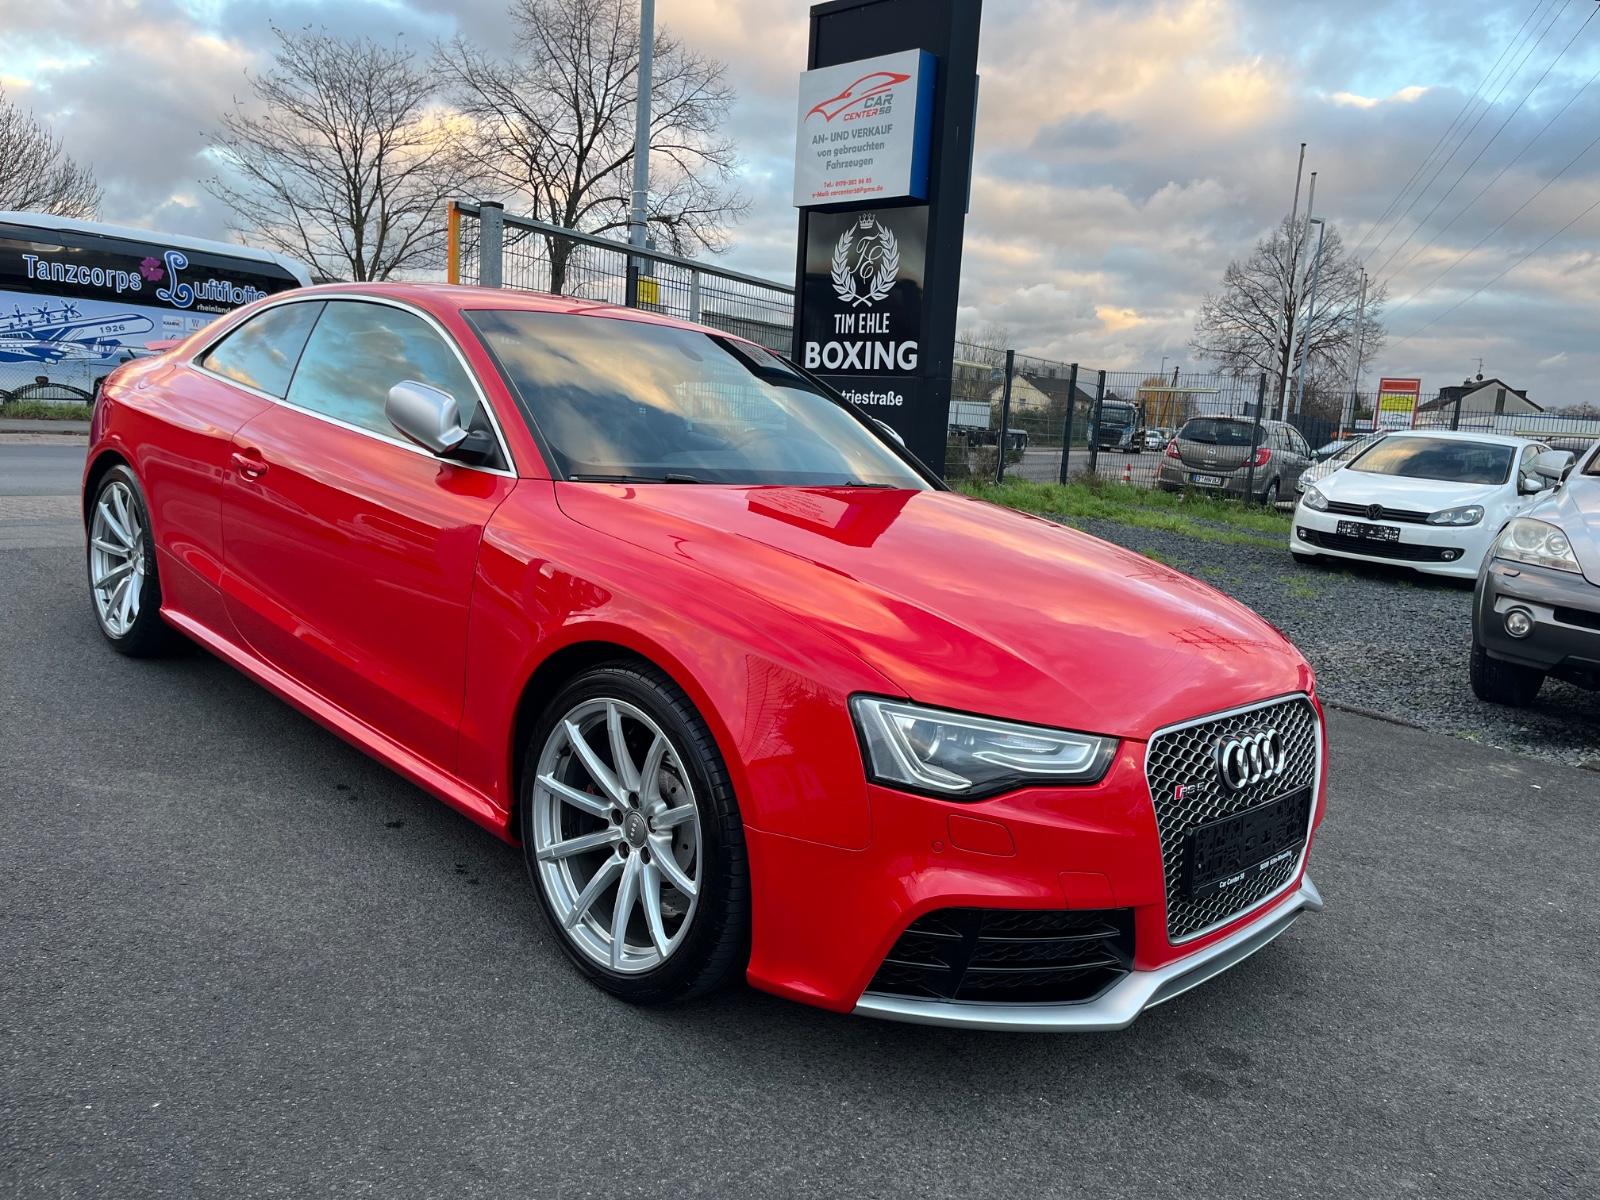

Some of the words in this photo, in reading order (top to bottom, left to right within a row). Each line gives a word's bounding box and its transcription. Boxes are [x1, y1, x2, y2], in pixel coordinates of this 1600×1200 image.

[864, 93, 894, 109] CAR
[812, 134, 828, 145] AN-
[830, 130, 849, 142] UND
[851, 124, 893, 139] VERKAUF
[817, 149, 832, 157] von
[833, 141, 885, 157] gebrauchten
[826, 158, 874, 170] Fahrzeugen
[23, 254, 142, 293] Tanzcorps
[156, 251, 268, 308] Luftflotte
[100, 324, 125, 334] 1926
[834, 314, 855, 334] TIM
[859, 313, 890, 333] EHLE
[805, 341, 919, 371] BOXING
